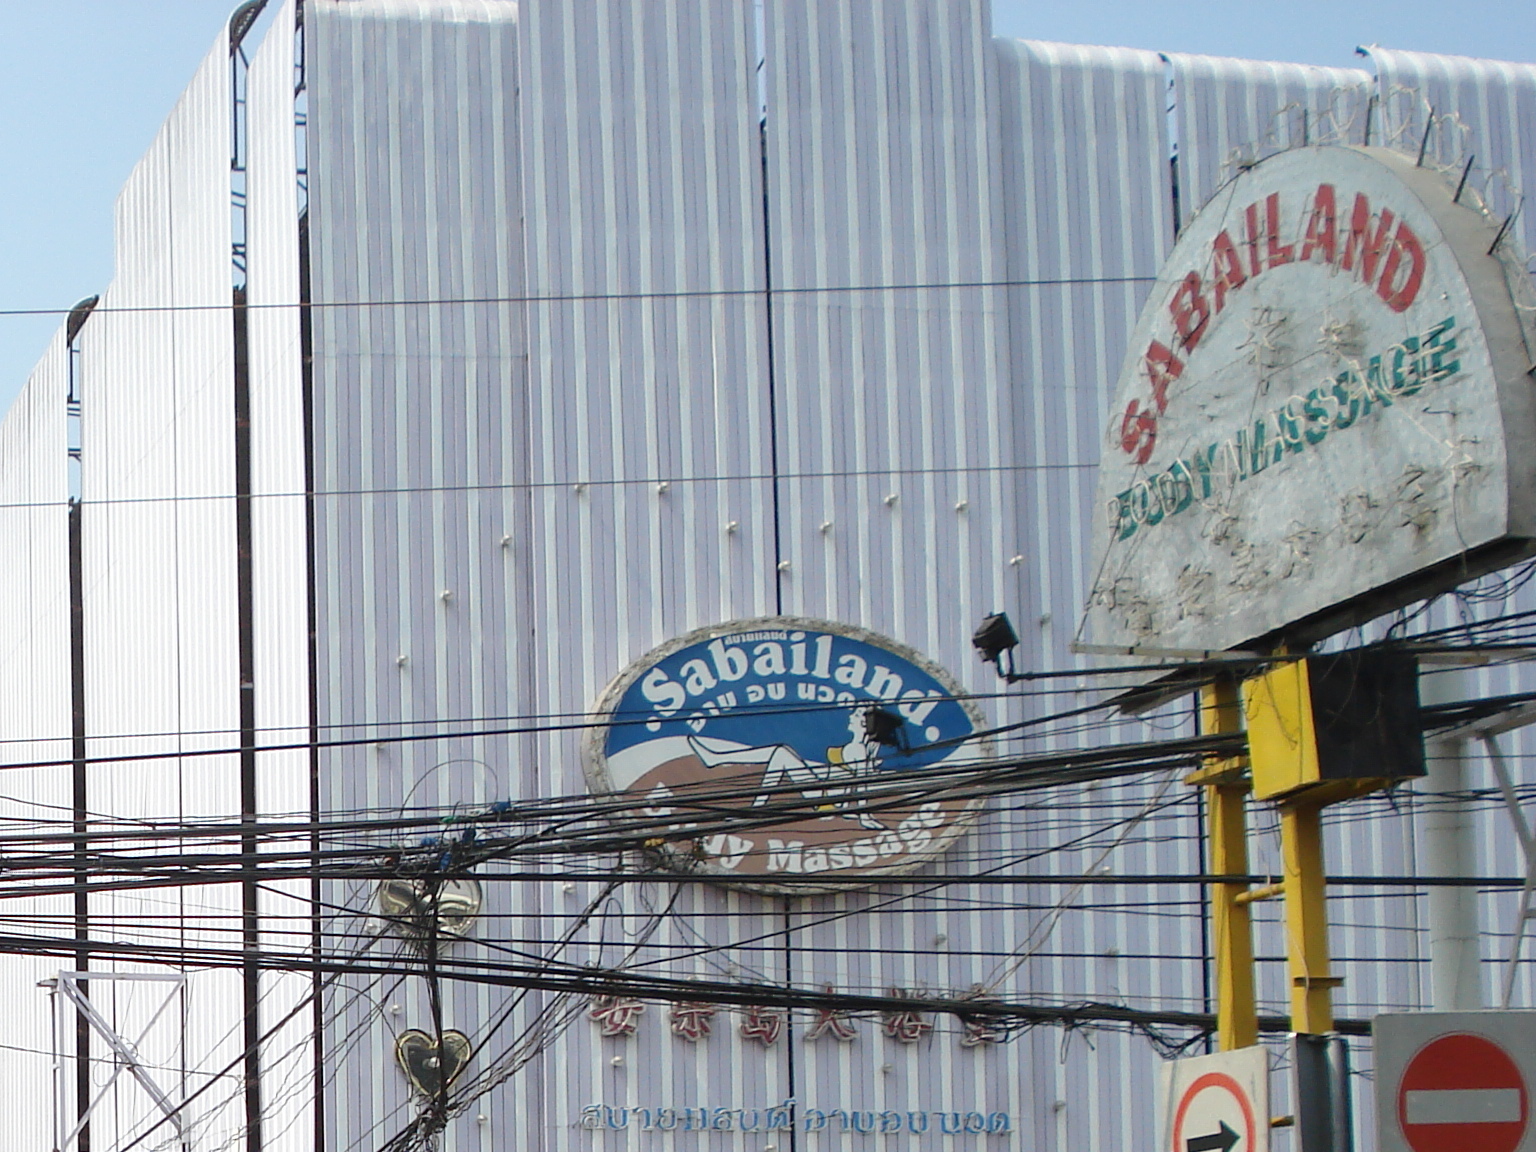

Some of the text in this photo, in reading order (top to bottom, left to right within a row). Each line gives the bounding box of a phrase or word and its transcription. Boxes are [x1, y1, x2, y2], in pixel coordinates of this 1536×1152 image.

[1121, 184, 1426, 464] SABAILAND
[641, 631, 943, 726] Sabailand
[767, 802, 946, 873] Massage
